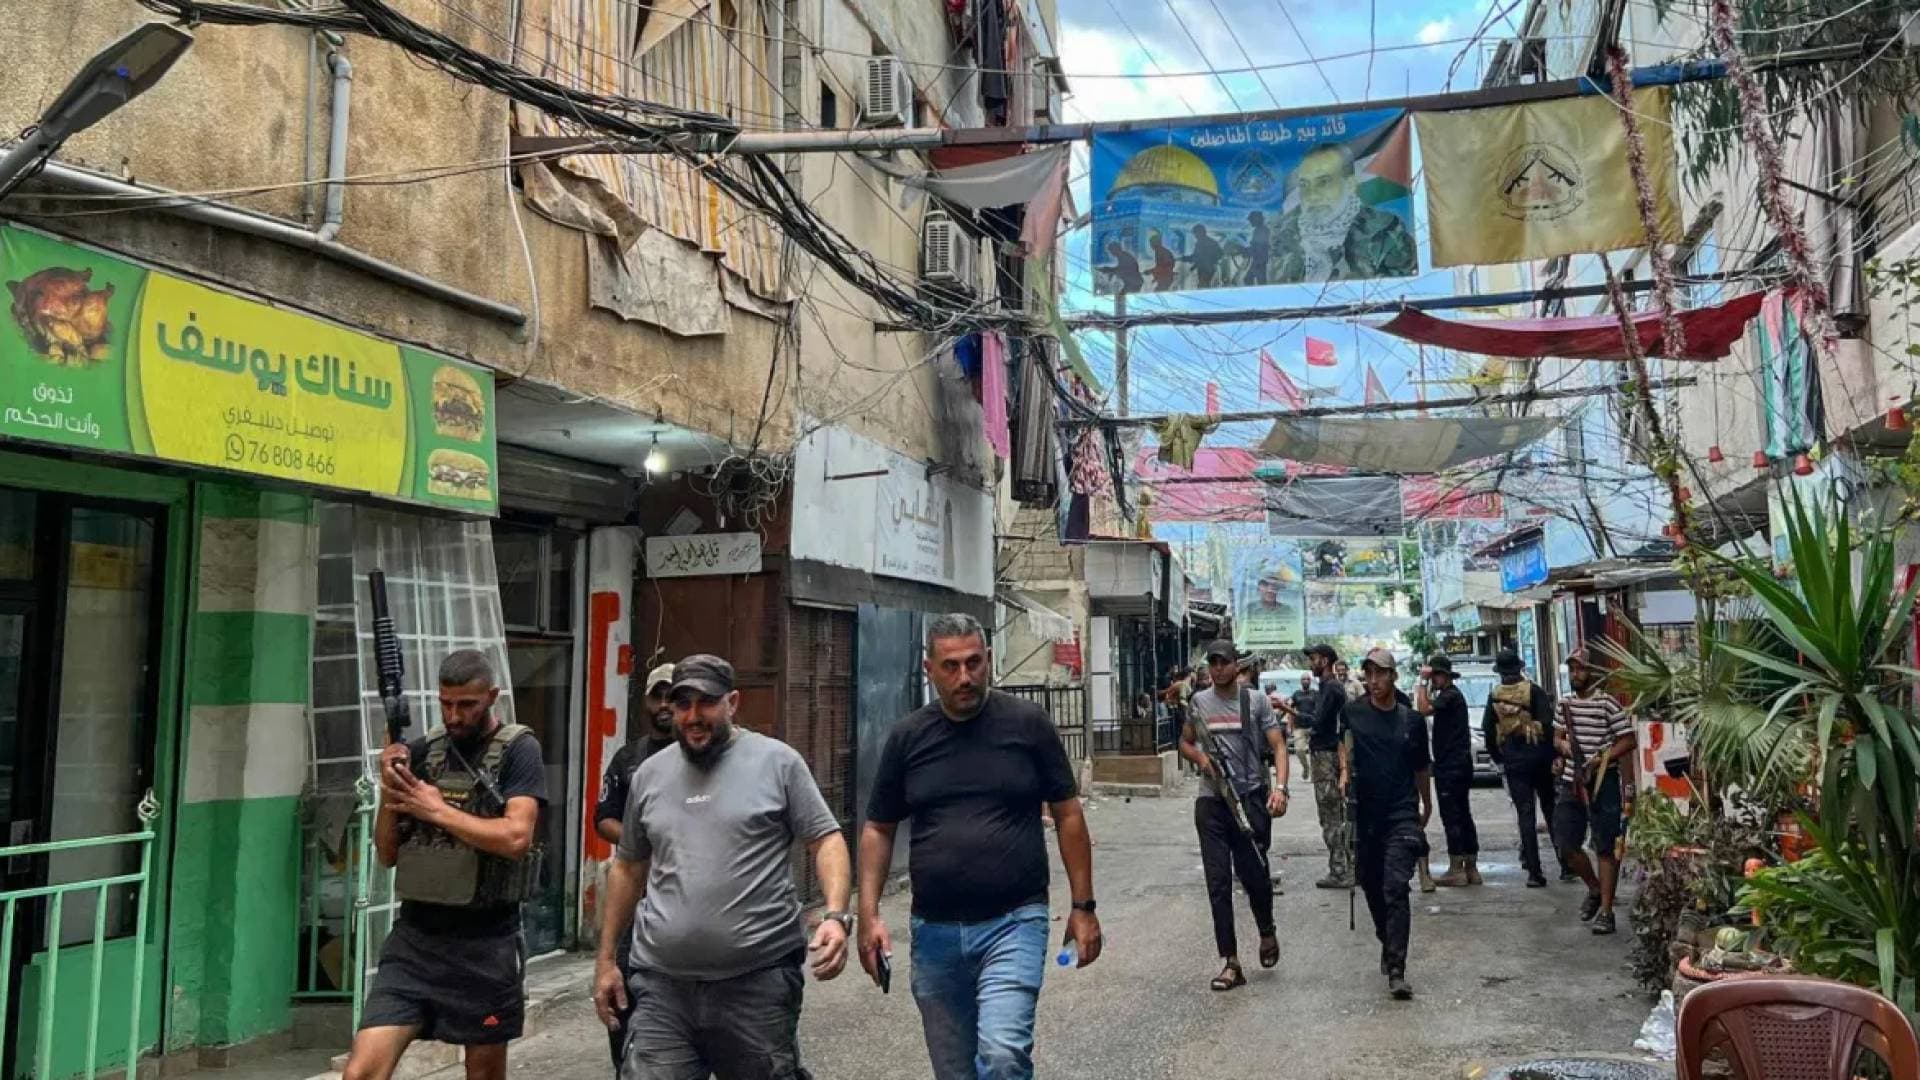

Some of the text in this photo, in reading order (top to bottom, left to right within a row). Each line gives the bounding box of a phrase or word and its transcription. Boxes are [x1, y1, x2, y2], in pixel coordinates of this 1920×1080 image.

[157, 312, 392, 410] سناك يوسف
[33, 382, 73, 404] تذوق
[4, 406, 100, 439] وأنت الحكم
[286, 417, 334, 443] توصيل
[248, 440, 335, 475] 76 808 466
